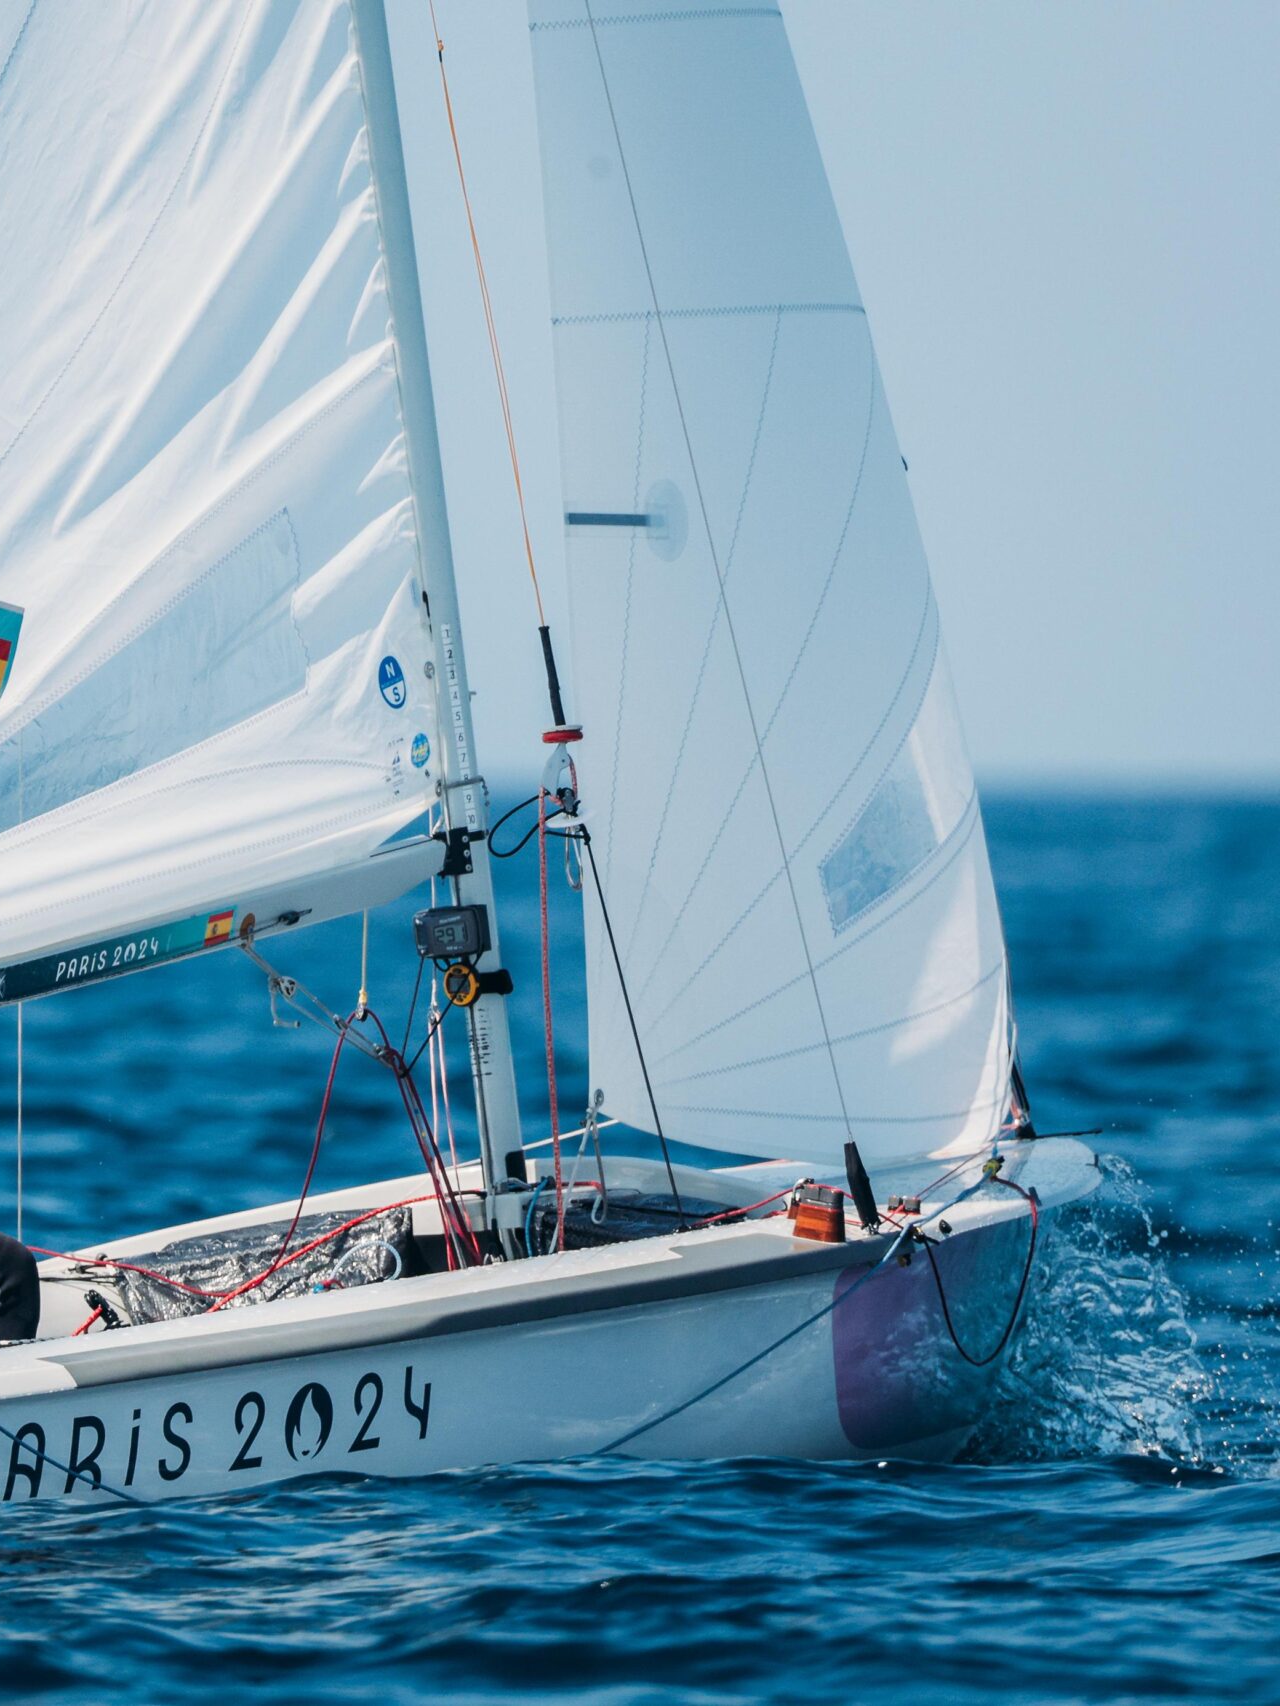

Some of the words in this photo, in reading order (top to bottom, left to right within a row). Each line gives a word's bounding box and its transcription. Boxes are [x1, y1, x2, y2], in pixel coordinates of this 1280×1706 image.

[384, 661, 396, 679] N
[392, 686, 401, 702] S
[112, 936, 159, 967] 2024
[227, 1366, 432, 1472] 2024
